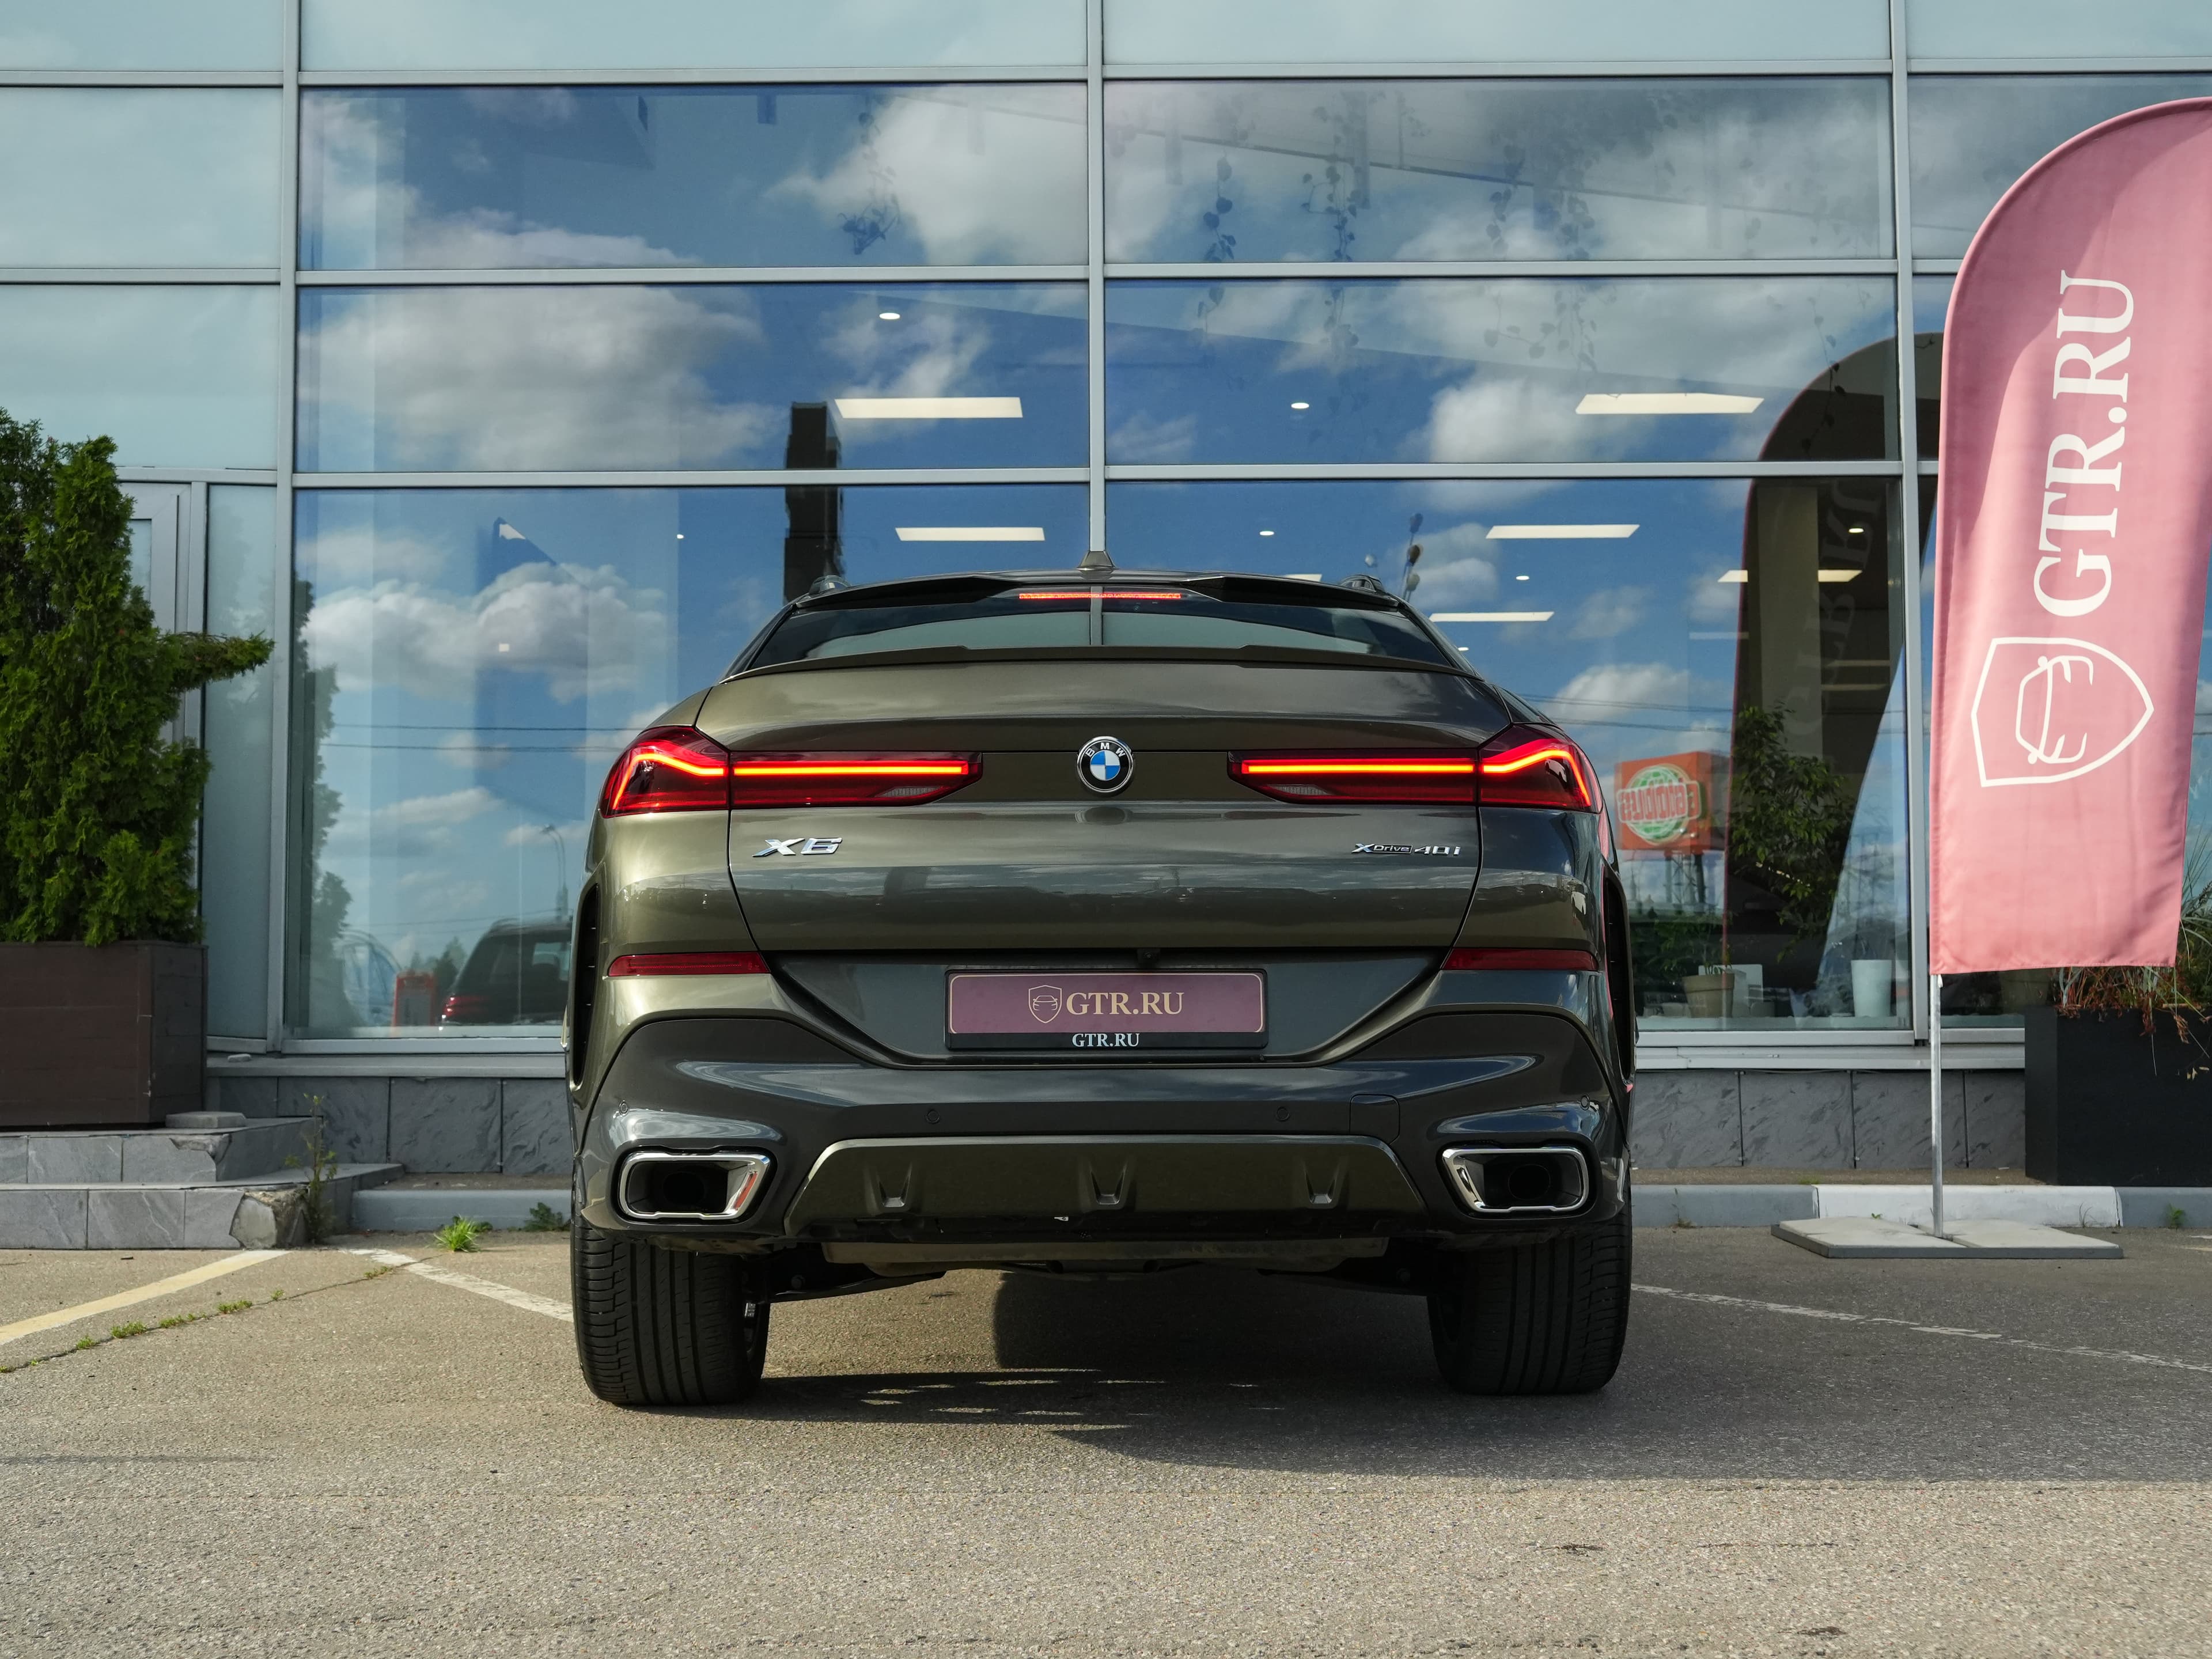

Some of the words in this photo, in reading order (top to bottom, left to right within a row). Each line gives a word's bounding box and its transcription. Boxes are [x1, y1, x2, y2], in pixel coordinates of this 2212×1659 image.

[2033, 269, 2134, 617] GTR.RU
[1085, 742, 1126, 758] BMW
[751, 838, 843, 858] X6
[1066, 992, 1184, 1015] GTR.RU
[1071, 1033, 1140, 1047] GTR.RU
